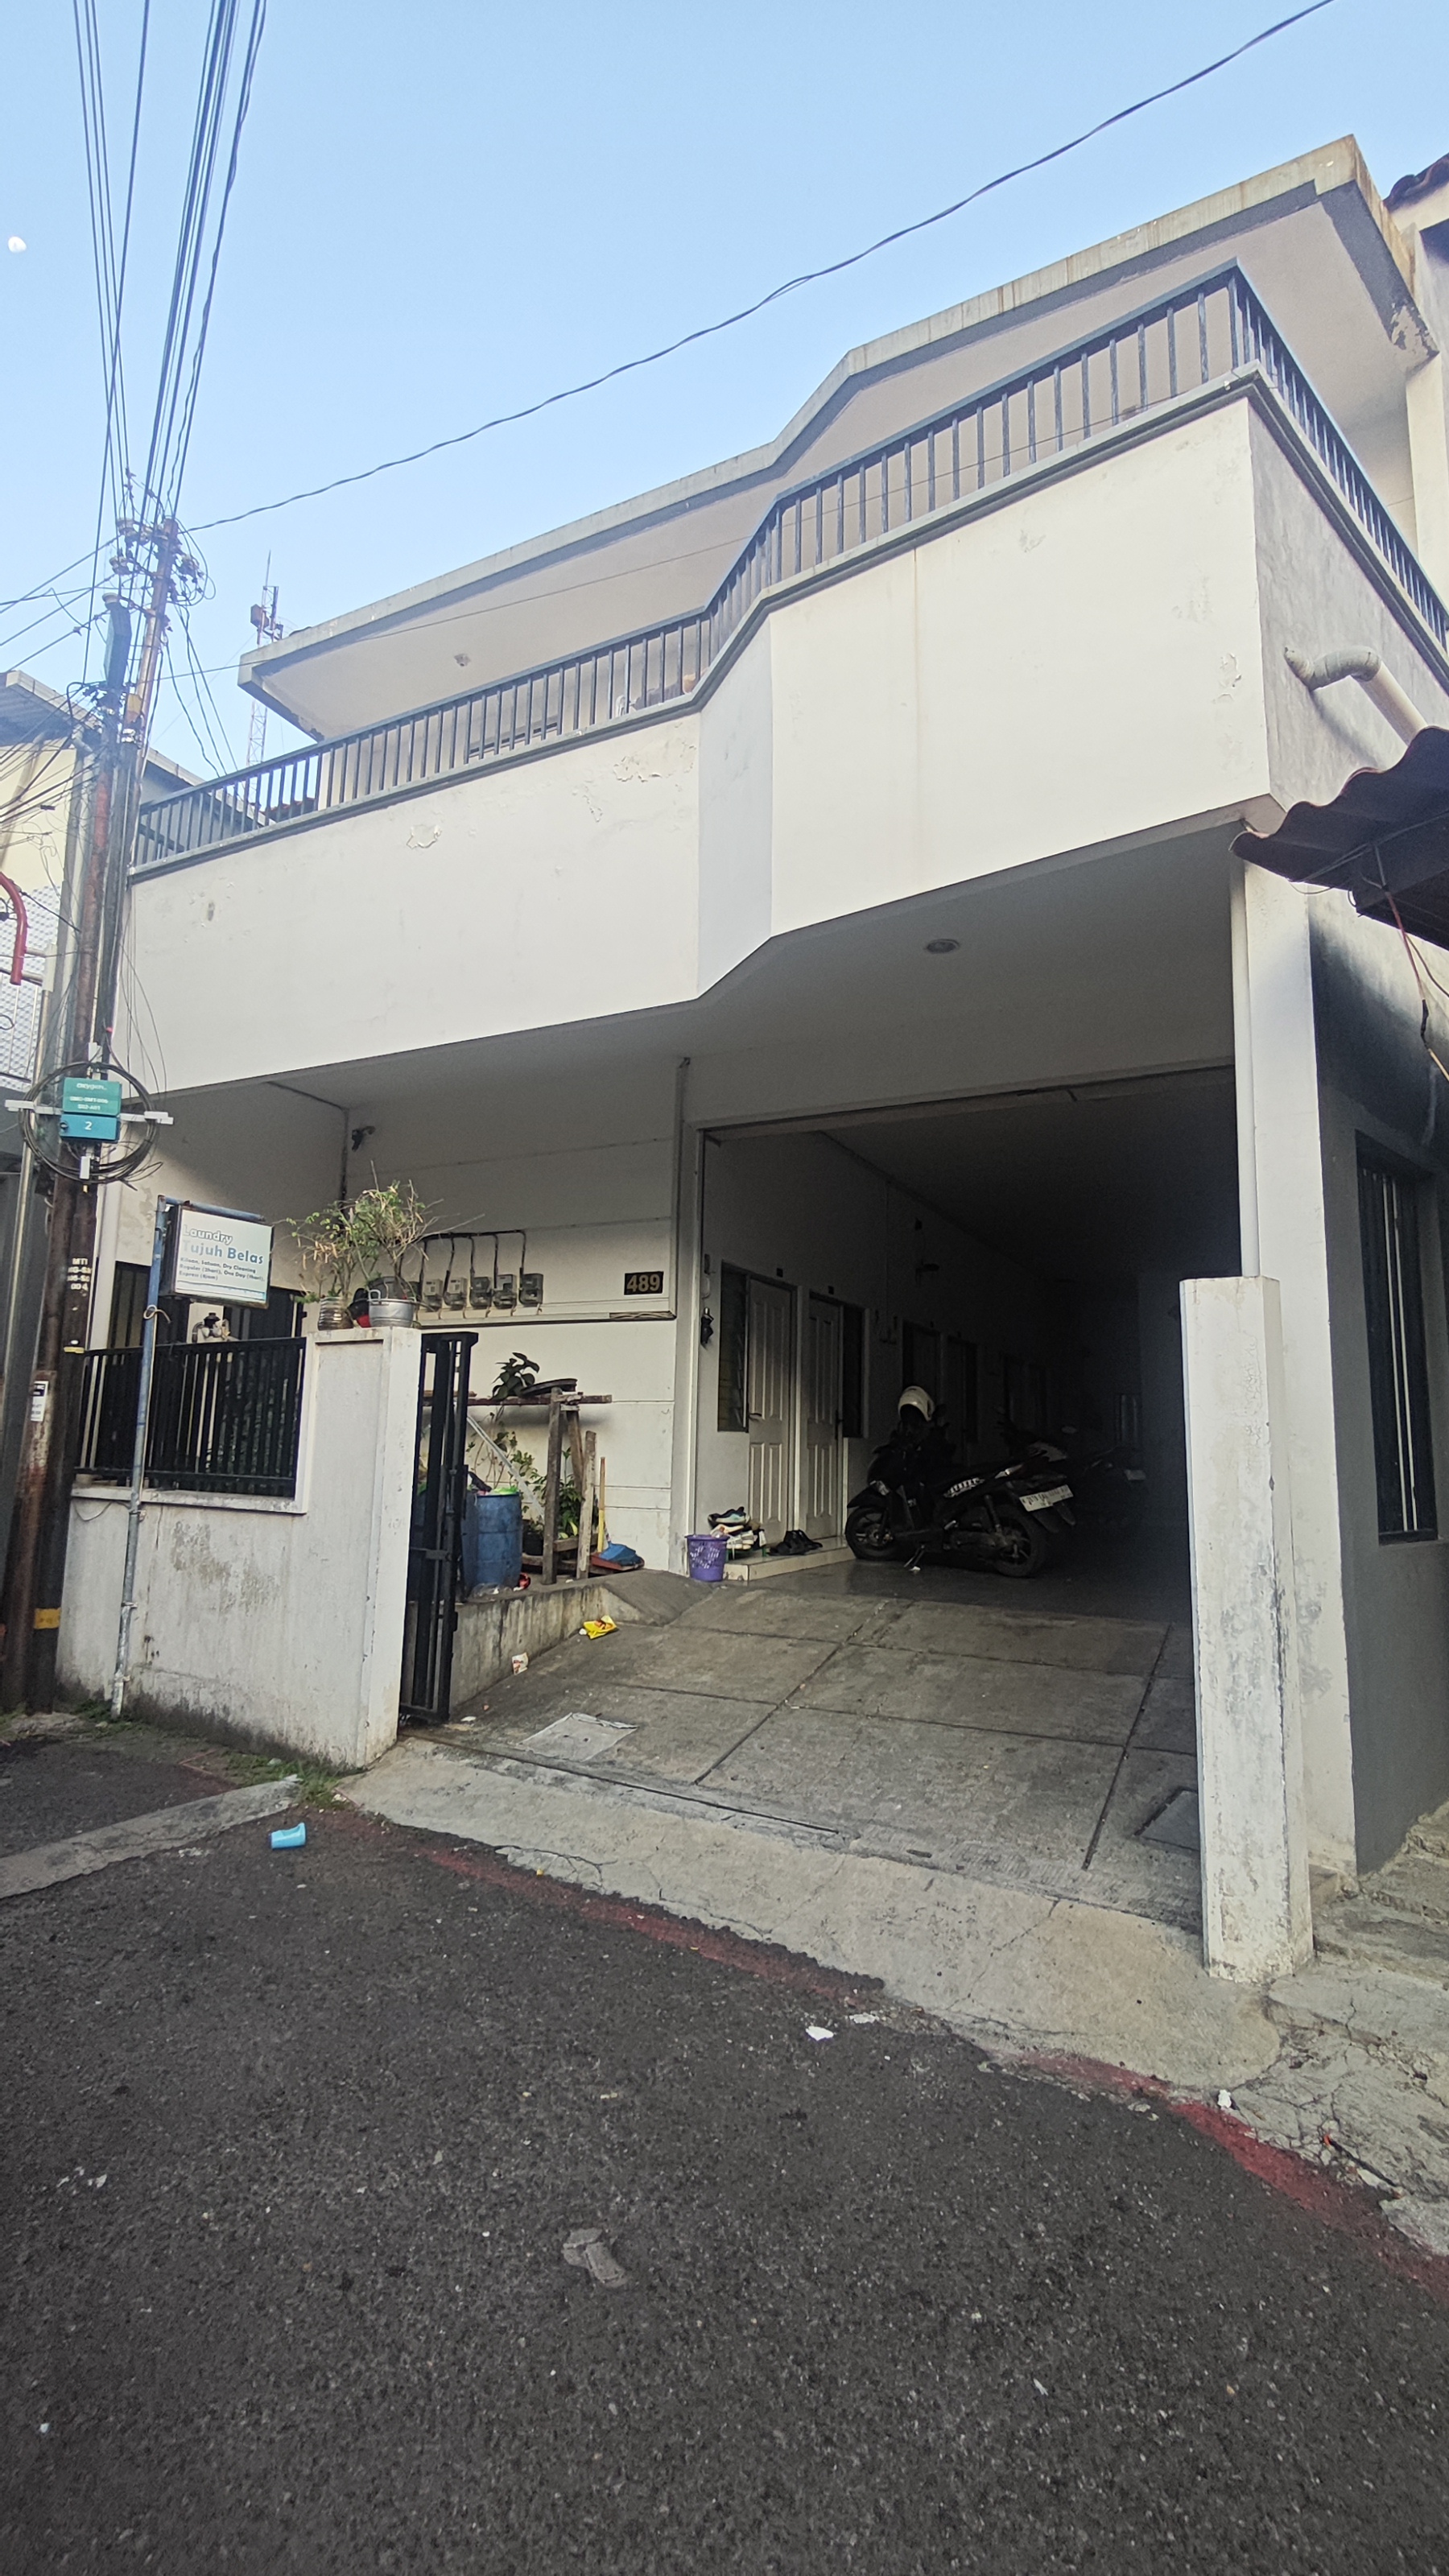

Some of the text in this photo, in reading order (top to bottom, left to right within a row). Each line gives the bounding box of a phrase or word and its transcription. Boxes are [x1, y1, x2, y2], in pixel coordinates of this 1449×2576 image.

[85, 1121, 93, 1130] 2
[183, 1224, 233, 1245] Laundry
[183, 1240, 263, 1264] Tujuh Belas
[233, 1265, 256, 1274] Cleaning
[626, 1274, 660, 1292] 489
